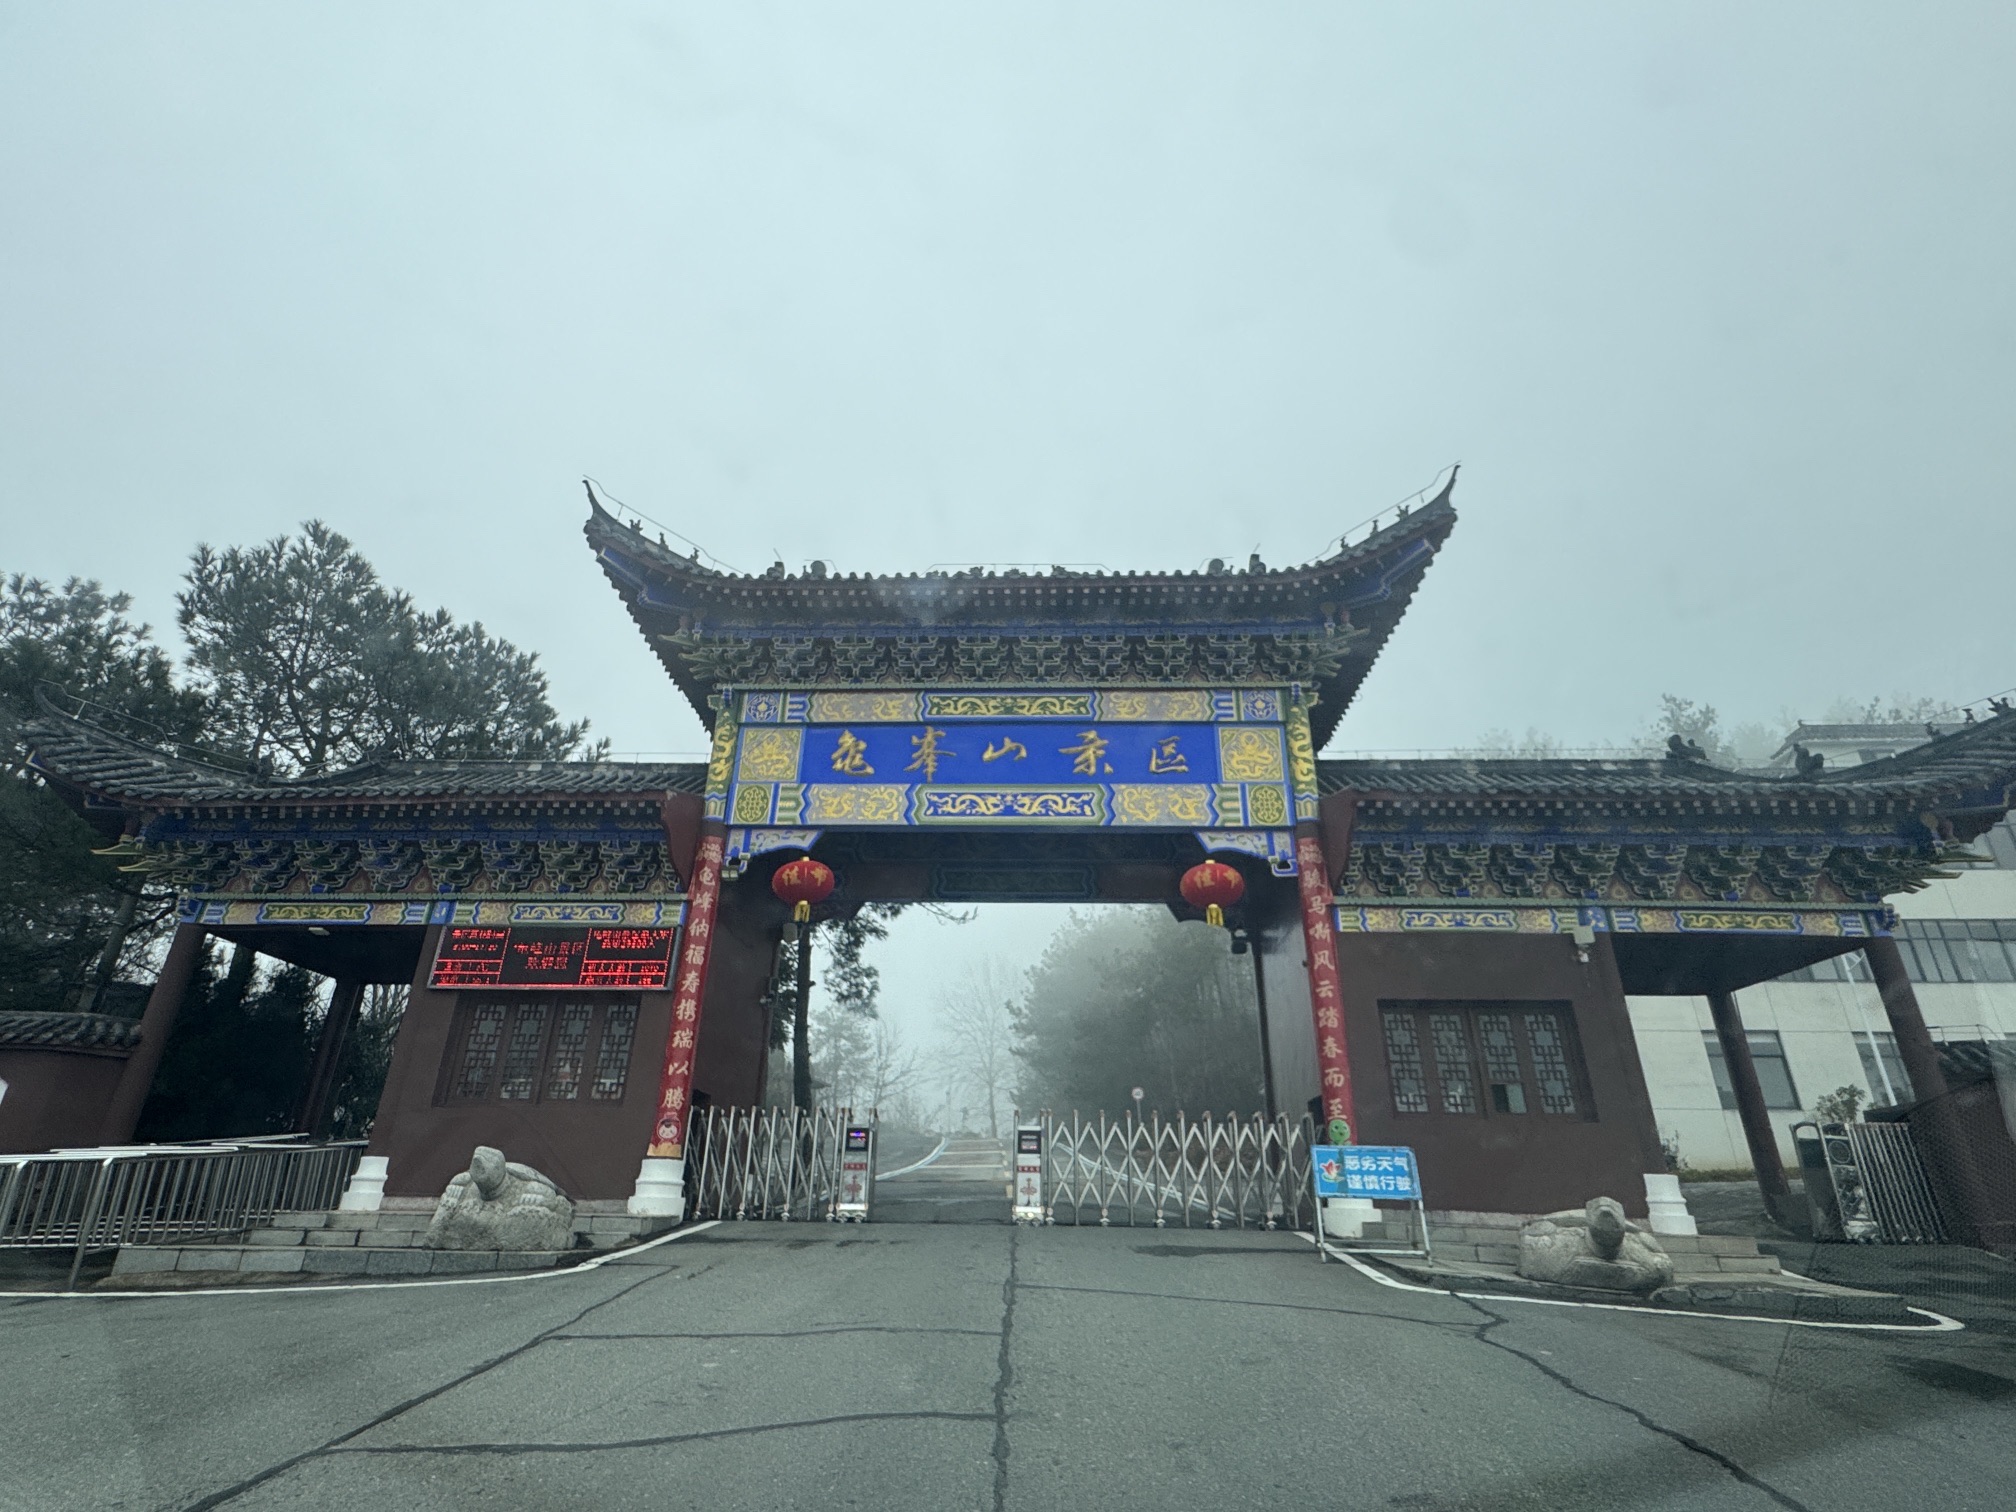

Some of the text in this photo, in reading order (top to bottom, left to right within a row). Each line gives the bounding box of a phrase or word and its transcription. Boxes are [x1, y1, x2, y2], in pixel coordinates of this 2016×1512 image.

[1344, 1155, 1409, 1171] 恶劣天气
[1347, 1174, 1411, 1191] 谨慎行驶
